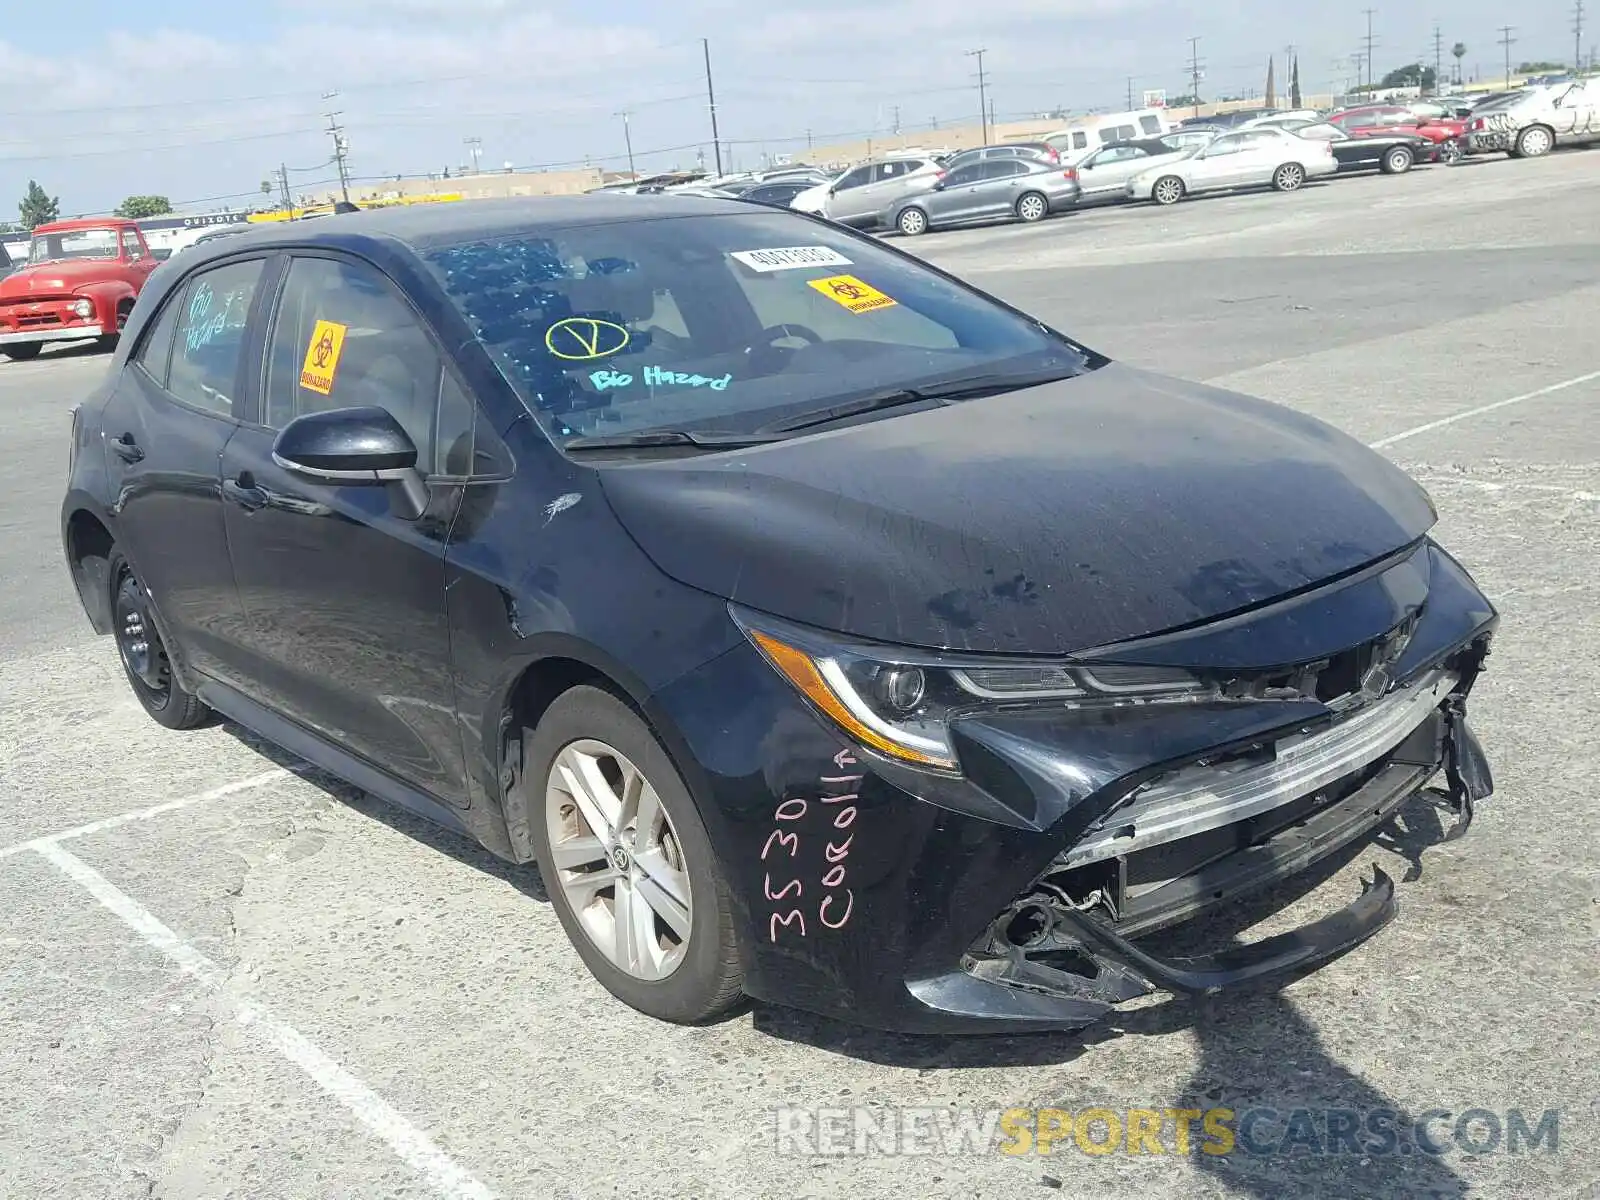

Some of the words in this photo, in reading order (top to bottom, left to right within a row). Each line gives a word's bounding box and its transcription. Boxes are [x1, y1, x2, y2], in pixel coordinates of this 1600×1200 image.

[847, 296, 894, 311] BIOHAZARD
[301, 371, 331, 390] BIOHAZARD
[760, 797, 807, 943] 3530
